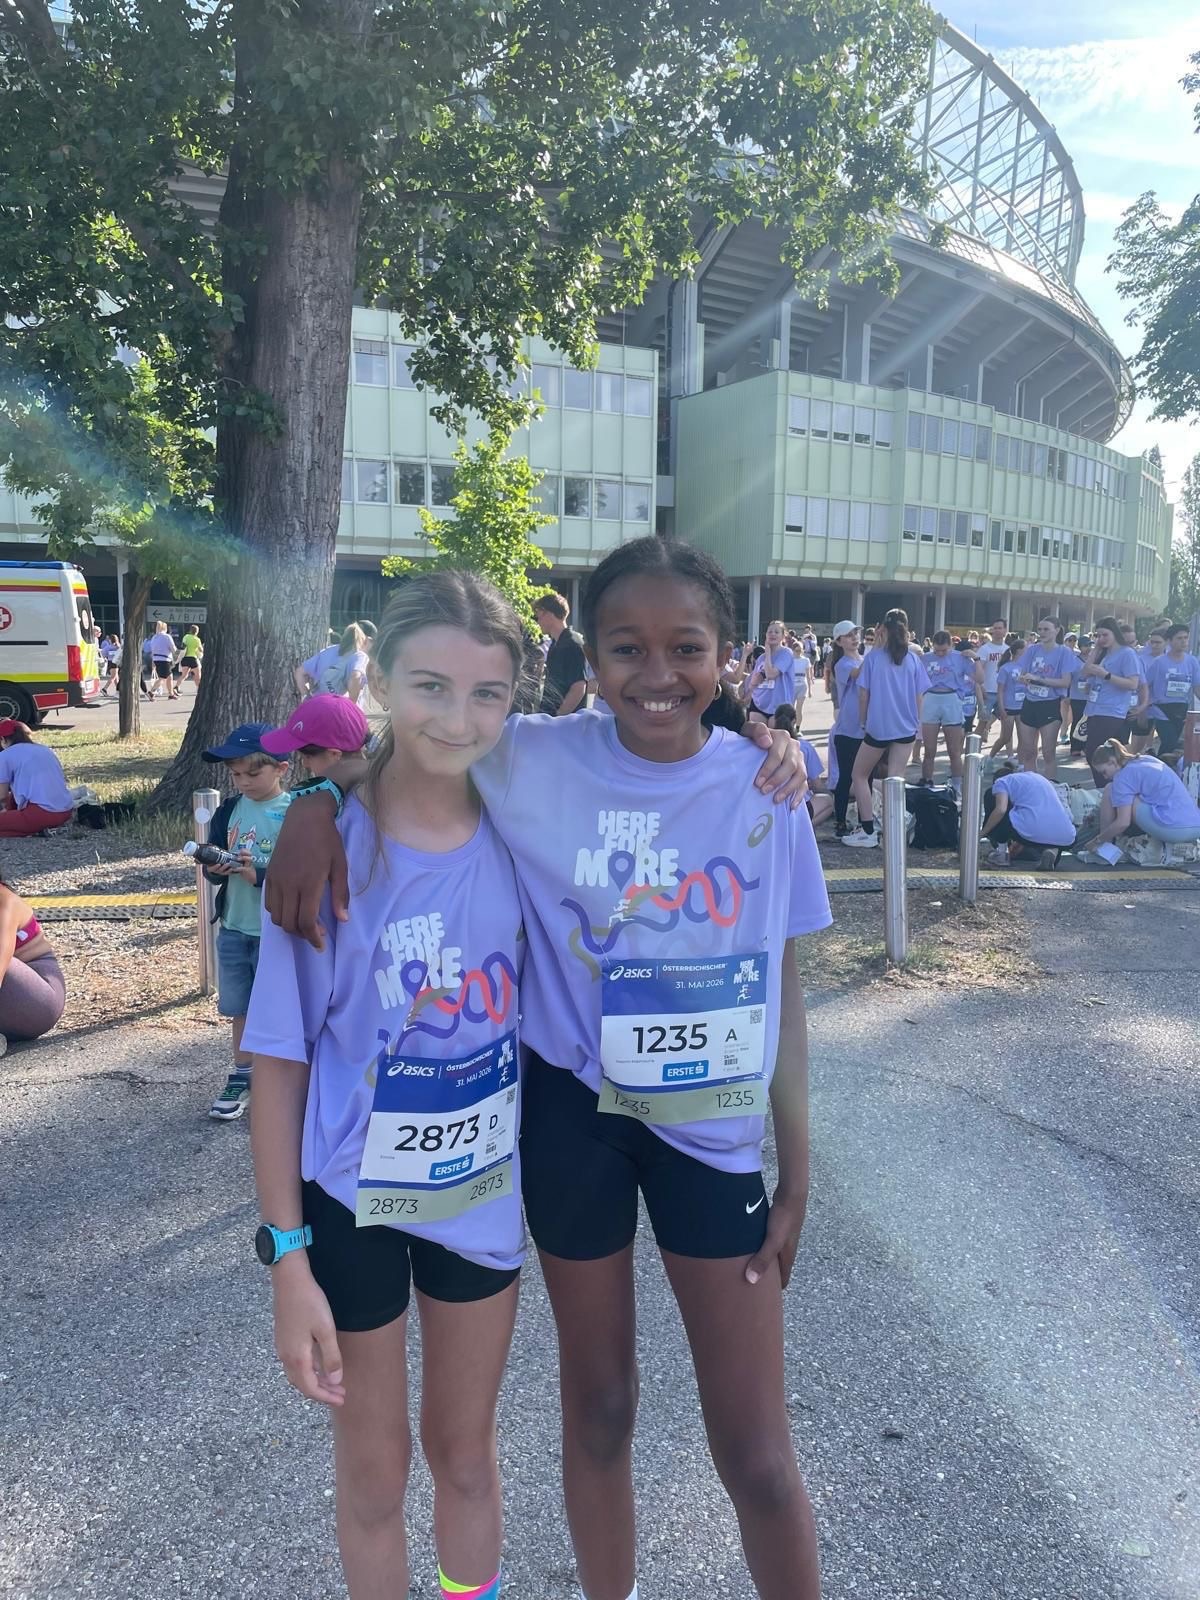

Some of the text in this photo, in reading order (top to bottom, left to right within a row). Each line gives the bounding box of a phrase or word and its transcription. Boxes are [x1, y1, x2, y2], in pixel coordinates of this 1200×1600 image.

[598, 810, 662, 837] HERE
[604, 832, 653, 857] FOR
[380, 912, 445, 952] HERE
[390, 936, 441, 967] FOR
[675, 979, 724, 989] 31. MAI 2026
[632, 1022, 708, 1054] 1235
[725, 1028, 738, 1043] A
[466, 1072, 478, 1085] MAI
[478, 1065, 493, 1078] 2026
[667, 1066, 694, 1077] ERSTE
[716, 1090, 754, 1109] 1235
[488, 1114, 498, 1130] D
[394, 1113, 481, 1152] 2873
[434, 1160, 462, 1176] ERSTE
[469, 1173, 503, 1201] 2873
[369, 1197, 419, 1216] 2873
